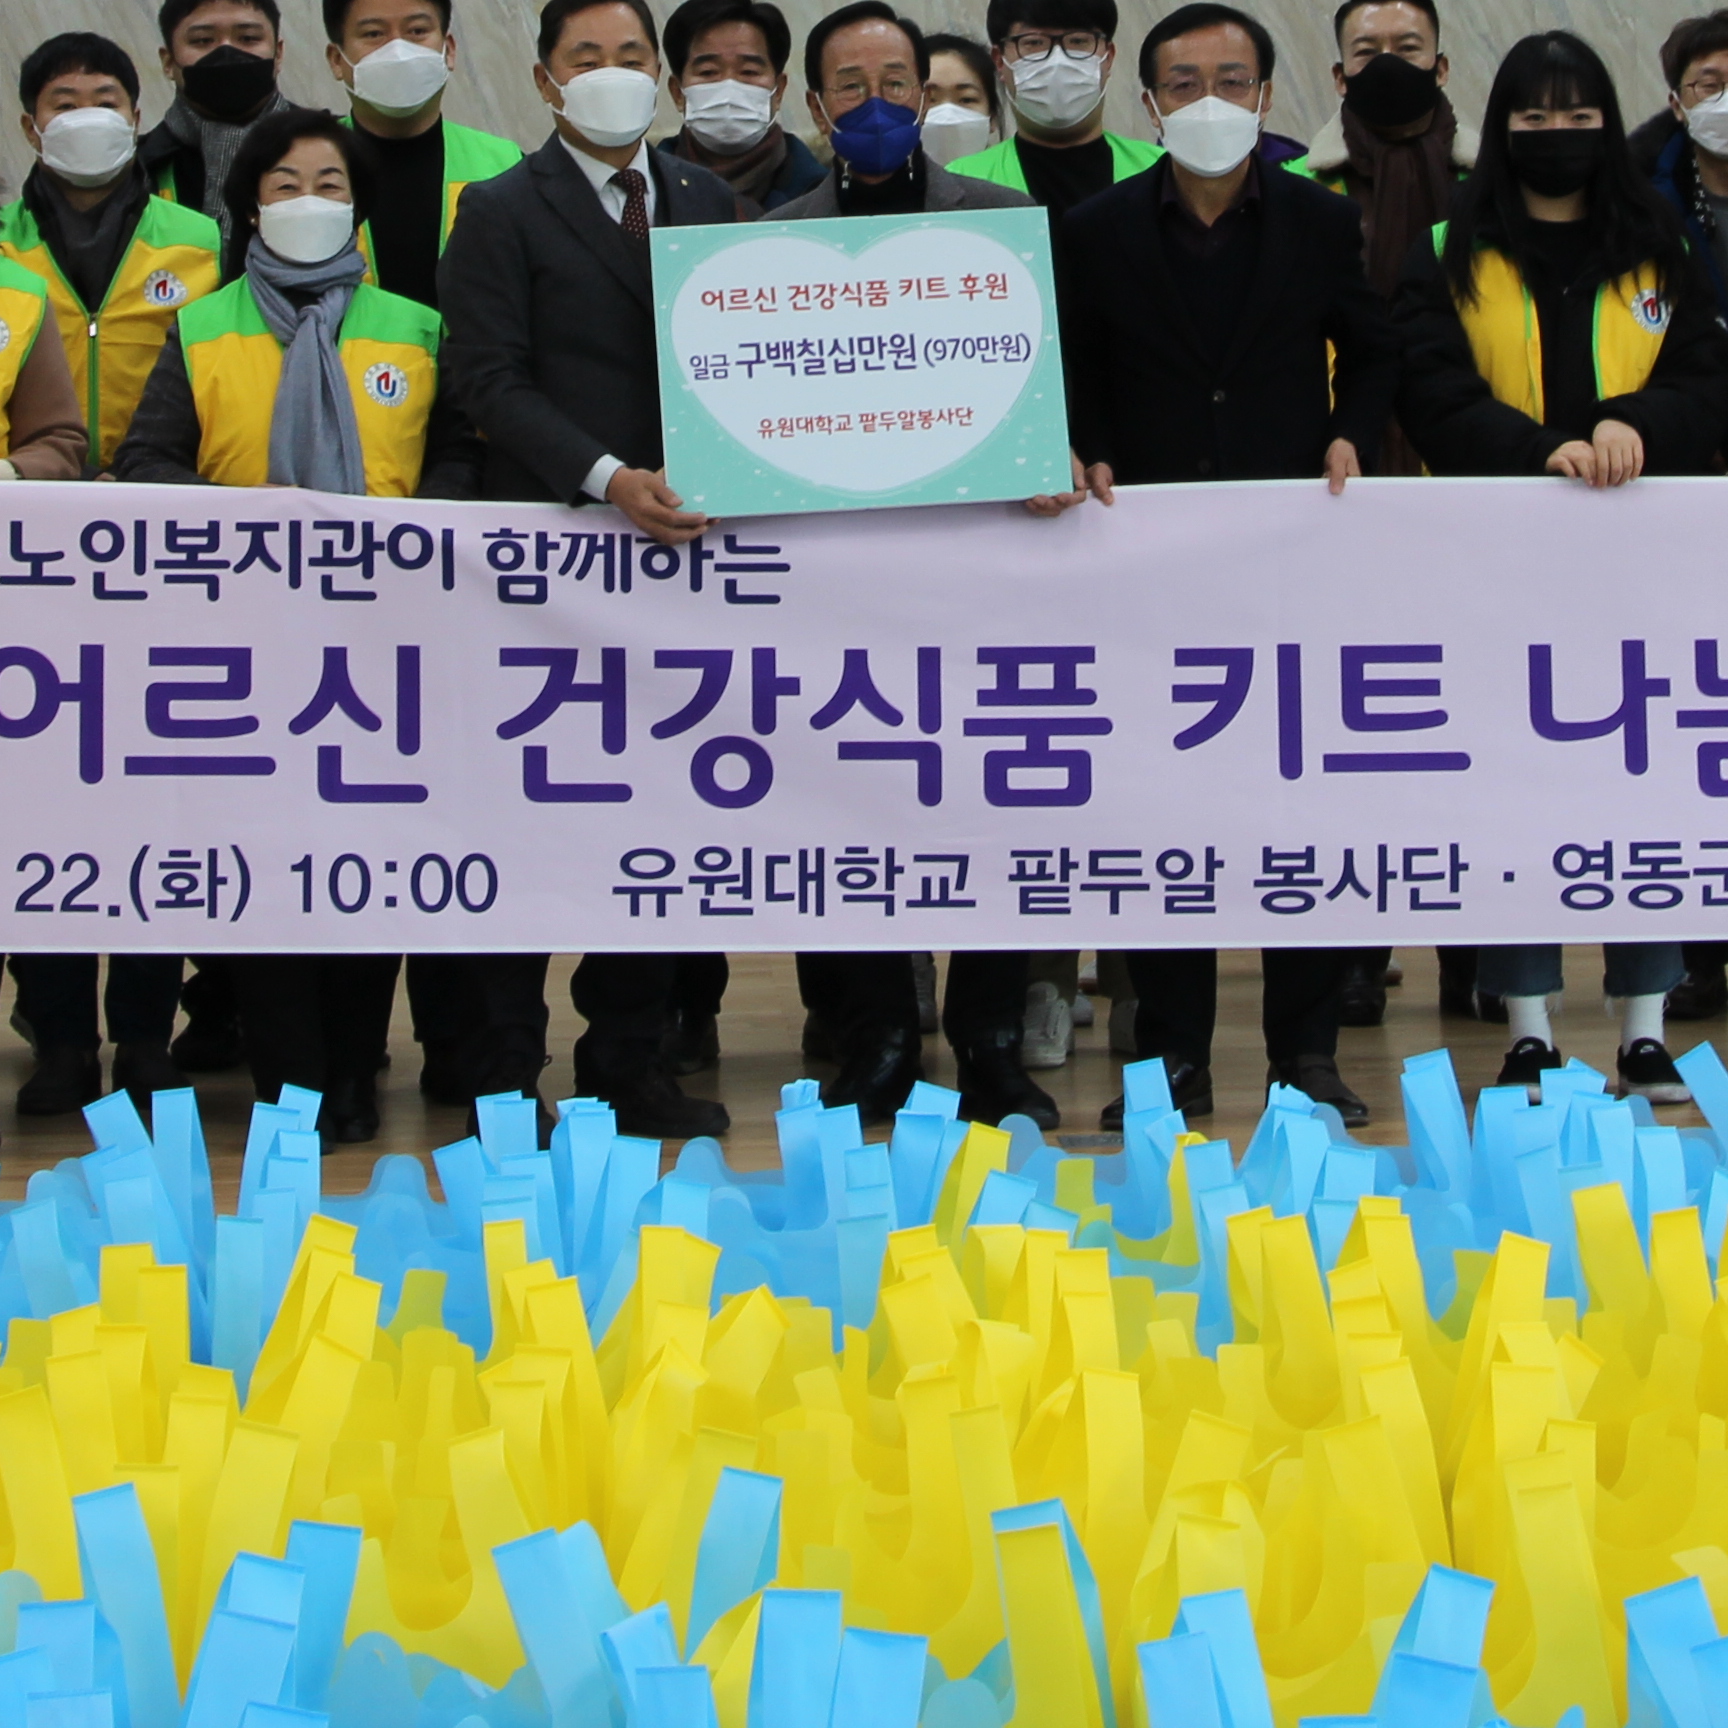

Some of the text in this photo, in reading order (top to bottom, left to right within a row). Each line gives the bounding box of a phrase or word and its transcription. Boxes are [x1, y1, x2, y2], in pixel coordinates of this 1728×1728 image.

[700, 272, 1009, 314] 어르신 건강식품 키트 후원
[689, 332, 1032, 381] 일금 구백칠십만원 (970만원)
[756, 406, 974, 440] 유원대학교 팥두알봉사단
[482, 523, 791, 605] 함께하는
[496, 645, 1113, 809] 건강식품
[1171, 643, 1472, 781] 키트
[15, 844, 251, 922] 22.(화)
[290, 852, 498, 914] 10:00
[612, 846, 977, 918] 유원대학교
[1008, 846, 1225, 915] 팥두알
[1253, 843, 1469, 915] 봉사단
